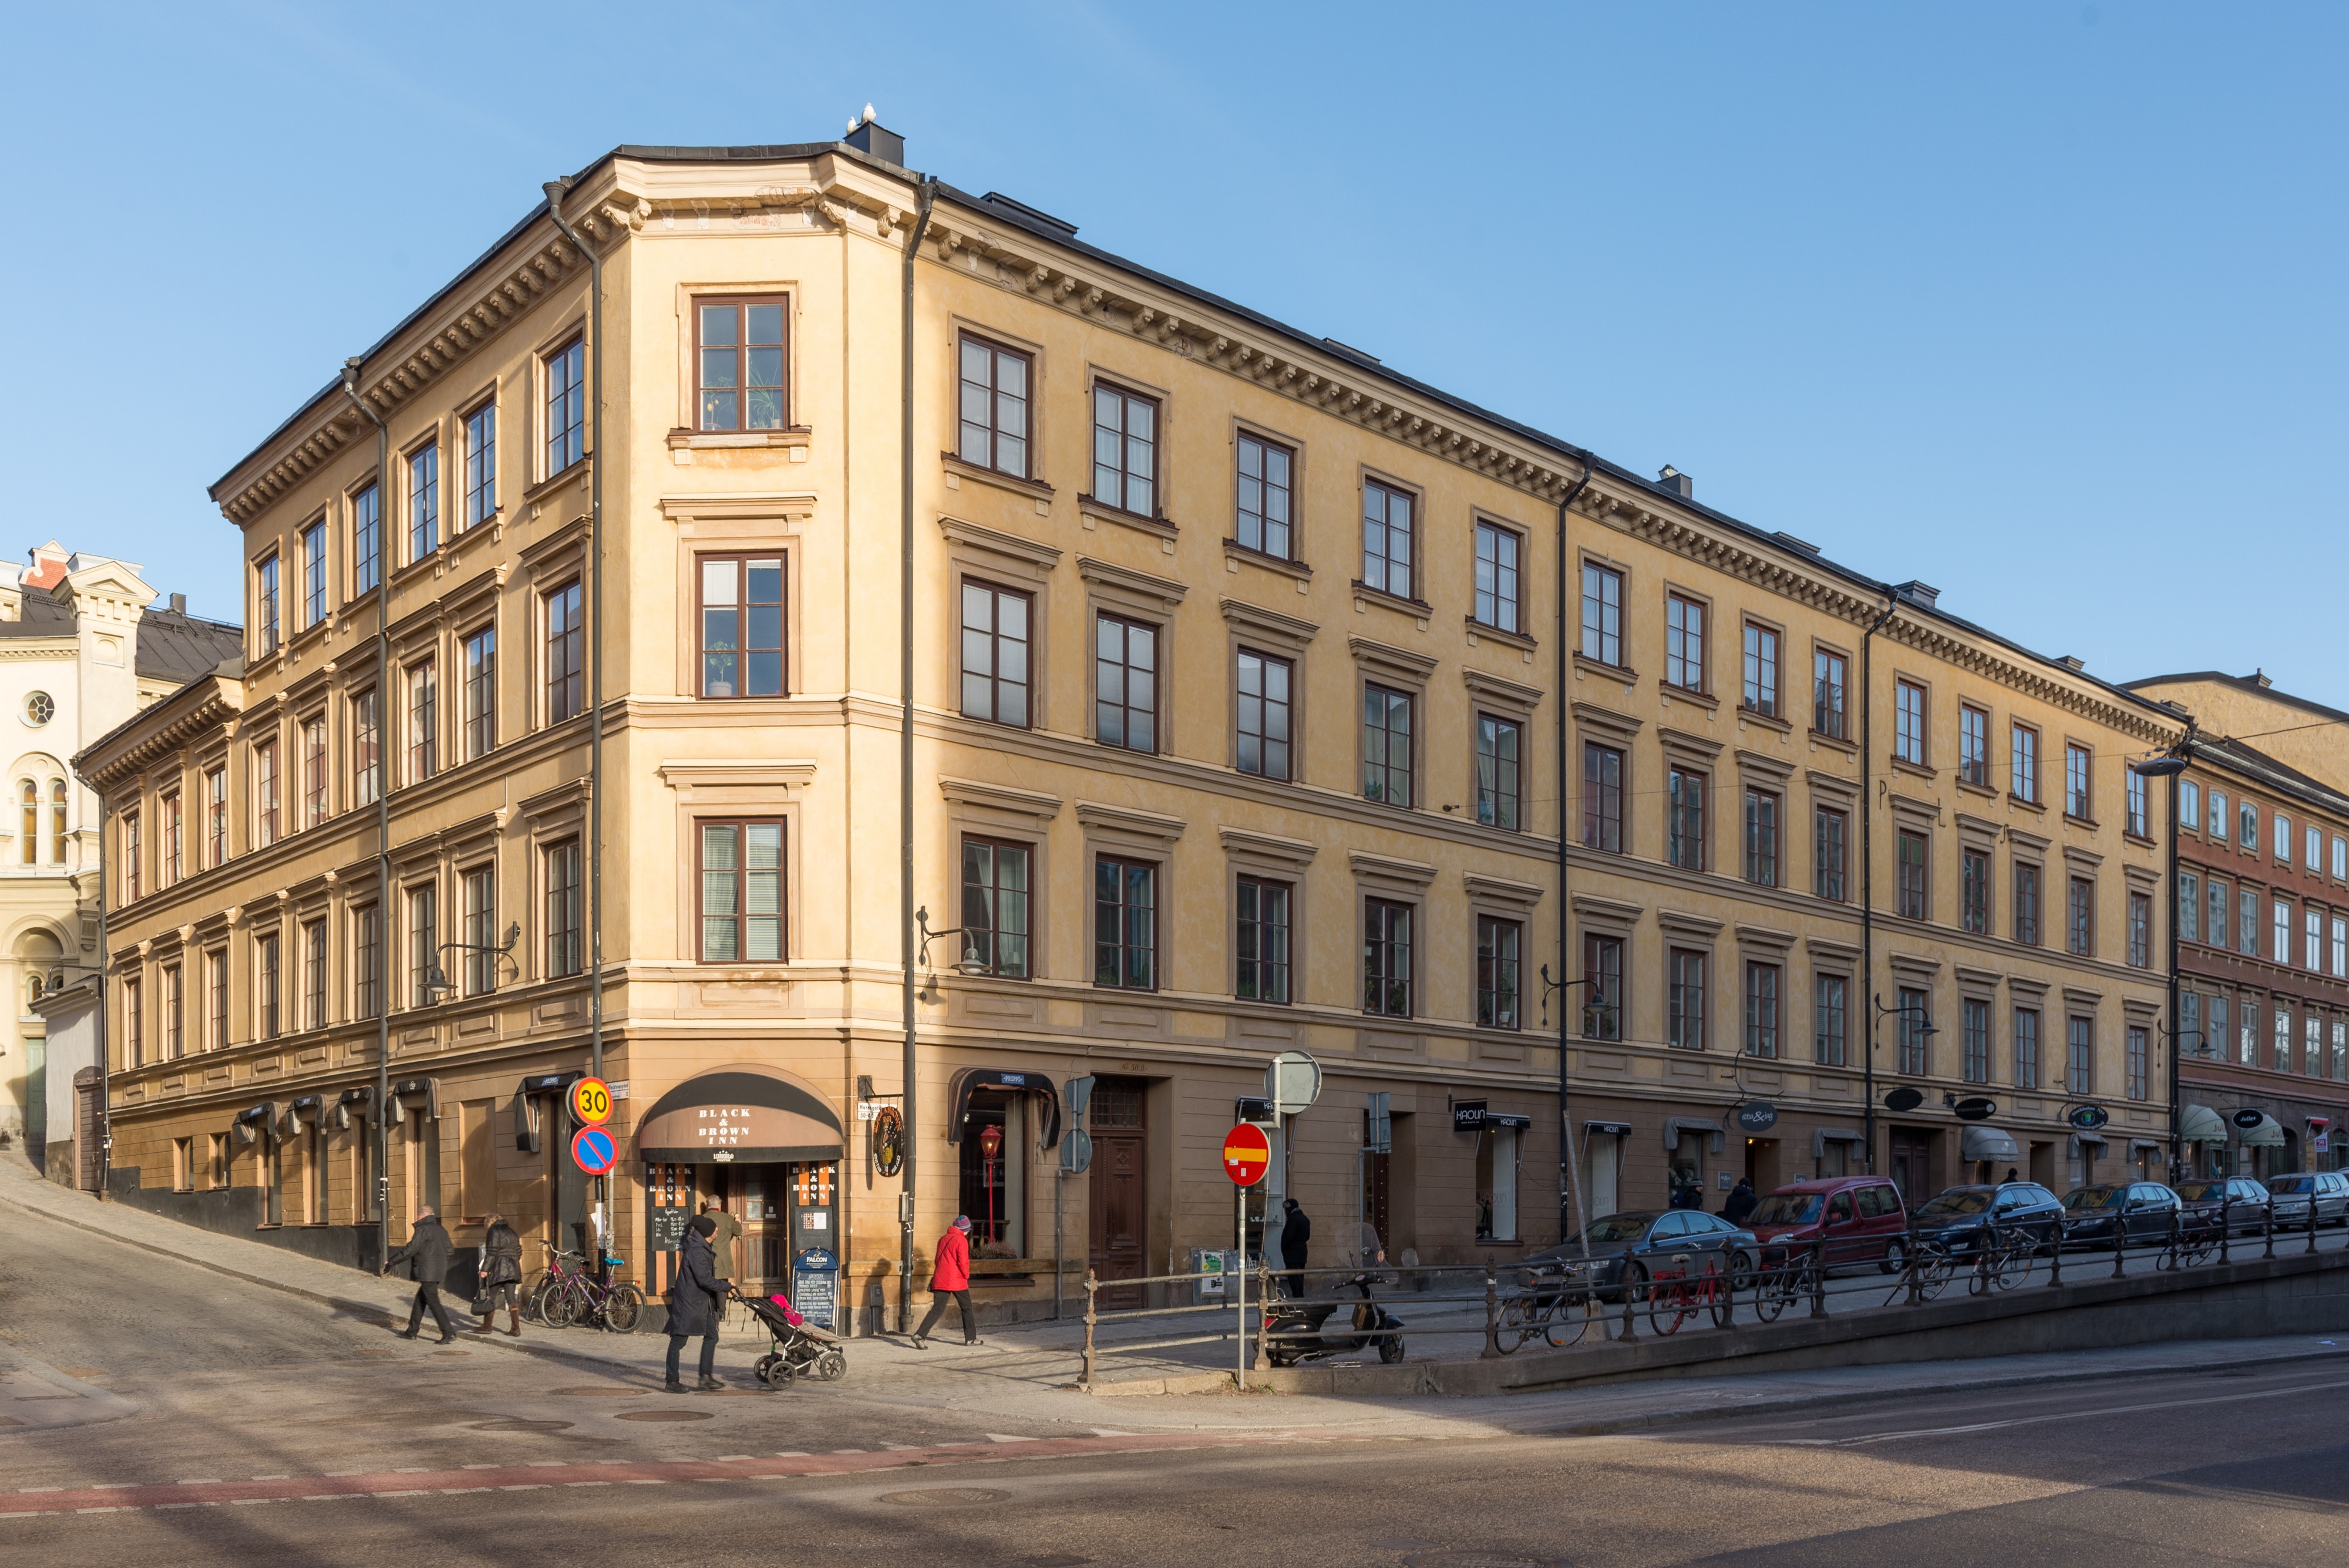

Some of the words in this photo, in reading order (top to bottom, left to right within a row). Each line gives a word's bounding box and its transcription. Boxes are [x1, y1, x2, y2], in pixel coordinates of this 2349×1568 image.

[581, 1089, 607, 1113] 30
[699, 1109, 751, 1118] BLACK
[1456, 1109, 1485, 1121] KAOLIN
[2071, 1106, 2095, 1116] Stockholms
[719, 1118, 728, 1126] &
[698, 1127, 750, 1136] BROWN
[708, 1136, 738, 1145] INN
